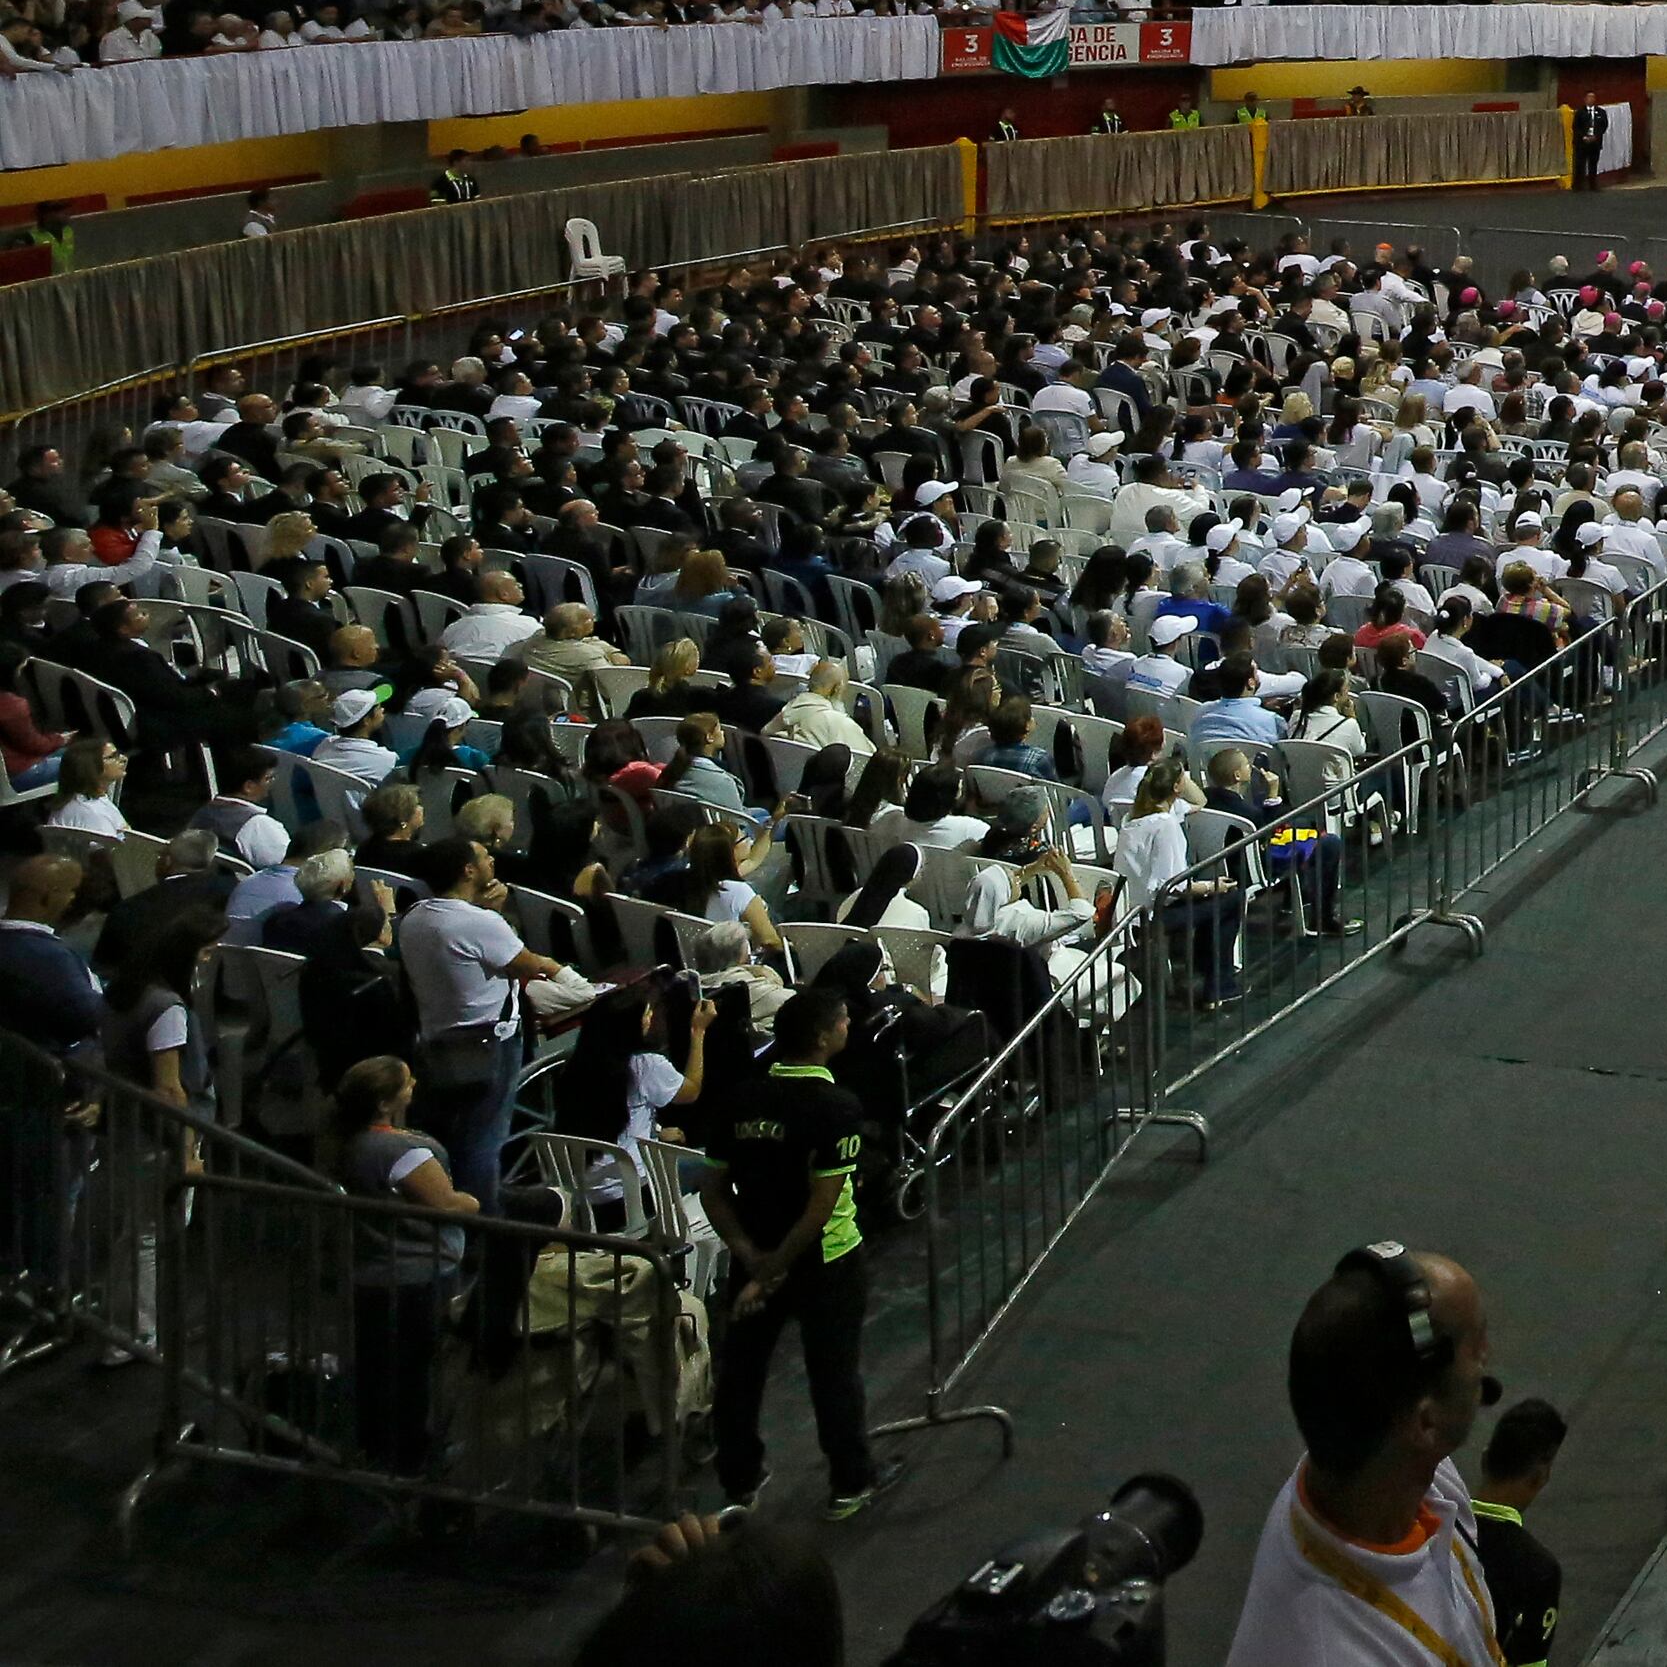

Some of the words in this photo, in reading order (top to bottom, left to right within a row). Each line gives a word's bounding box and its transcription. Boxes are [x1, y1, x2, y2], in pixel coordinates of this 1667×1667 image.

[965, 34, 979, 53] 3
[1094, 26, 1117, 43] DE
[1160, 28, 1173, 47] 3
[836, 1134, 862, 1161] 10
[1542, 1606, 1558, 1641] 9
